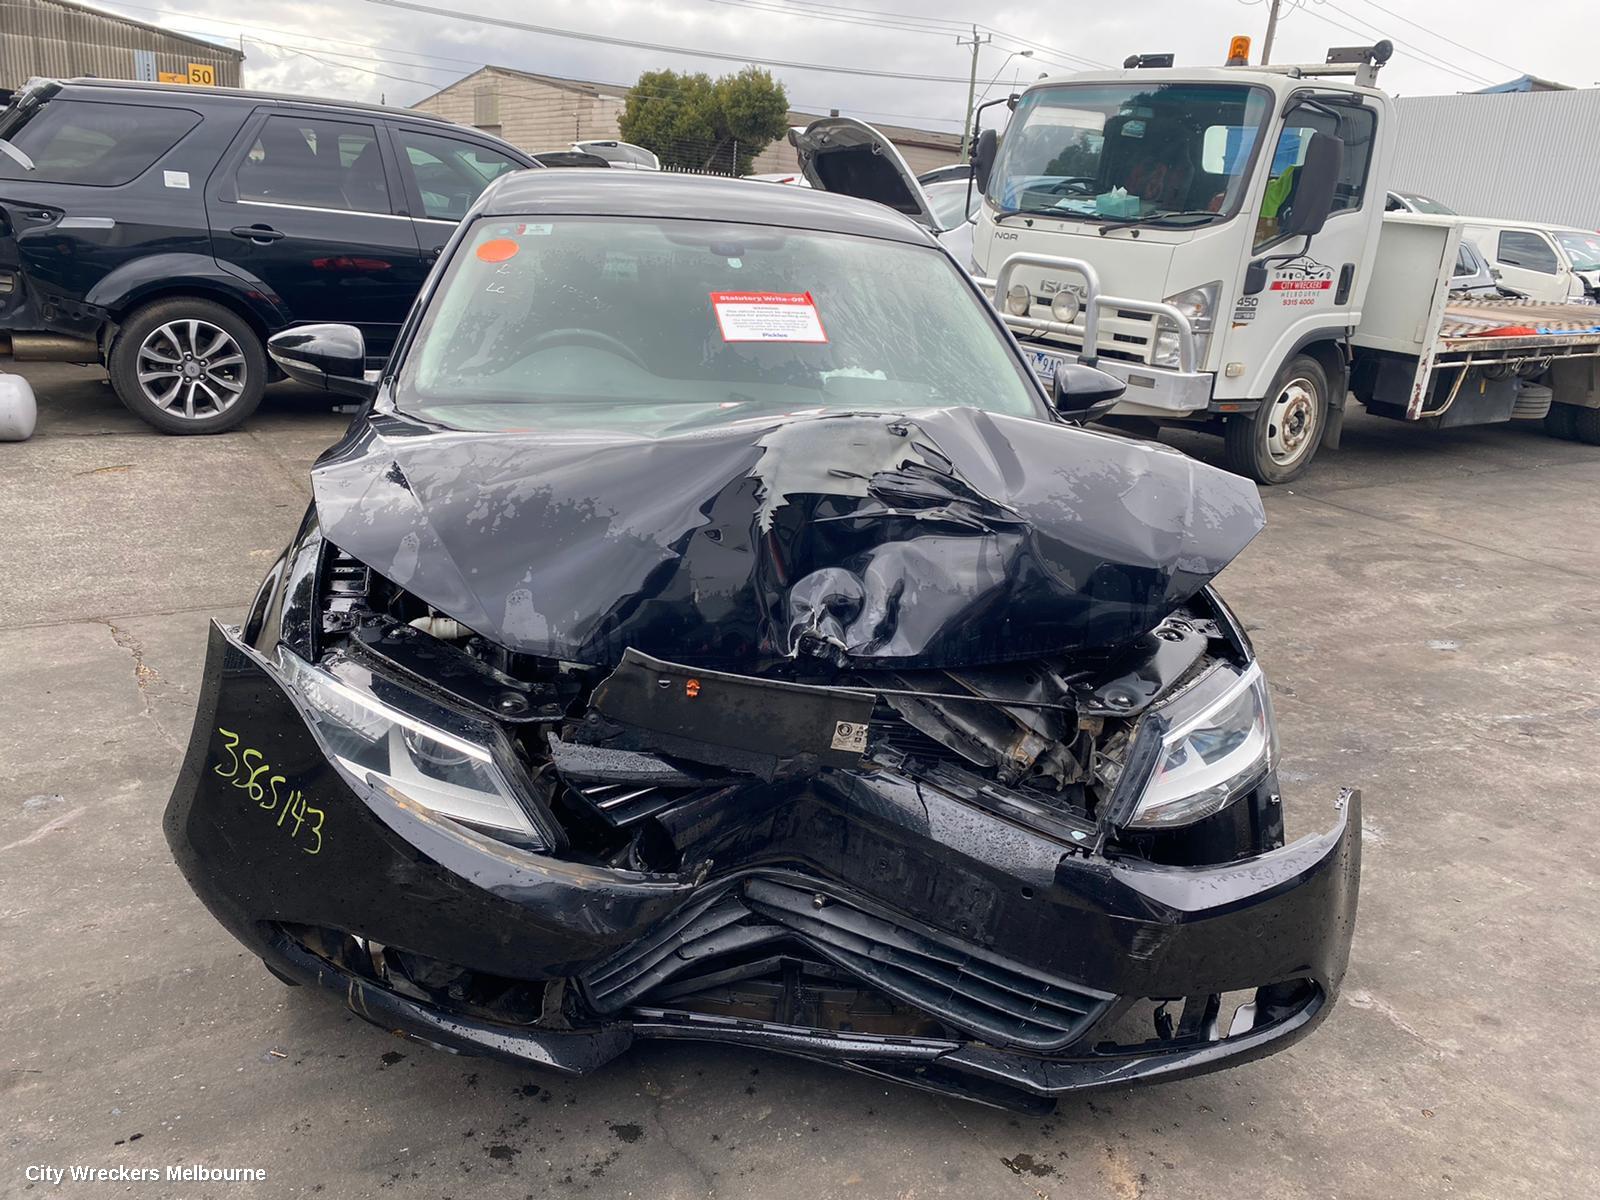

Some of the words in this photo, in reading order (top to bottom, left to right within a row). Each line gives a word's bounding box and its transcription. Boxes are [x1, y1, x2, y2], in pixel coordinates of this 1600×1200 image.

[192, 69, 211, 84] 50
[1281, 280, 1294, 289] CITY
[1295, 280, 1322, 289] WRECKERS
[1237, 297, 1259, 306] 450
[213, 727, 325, 854] 3565143
